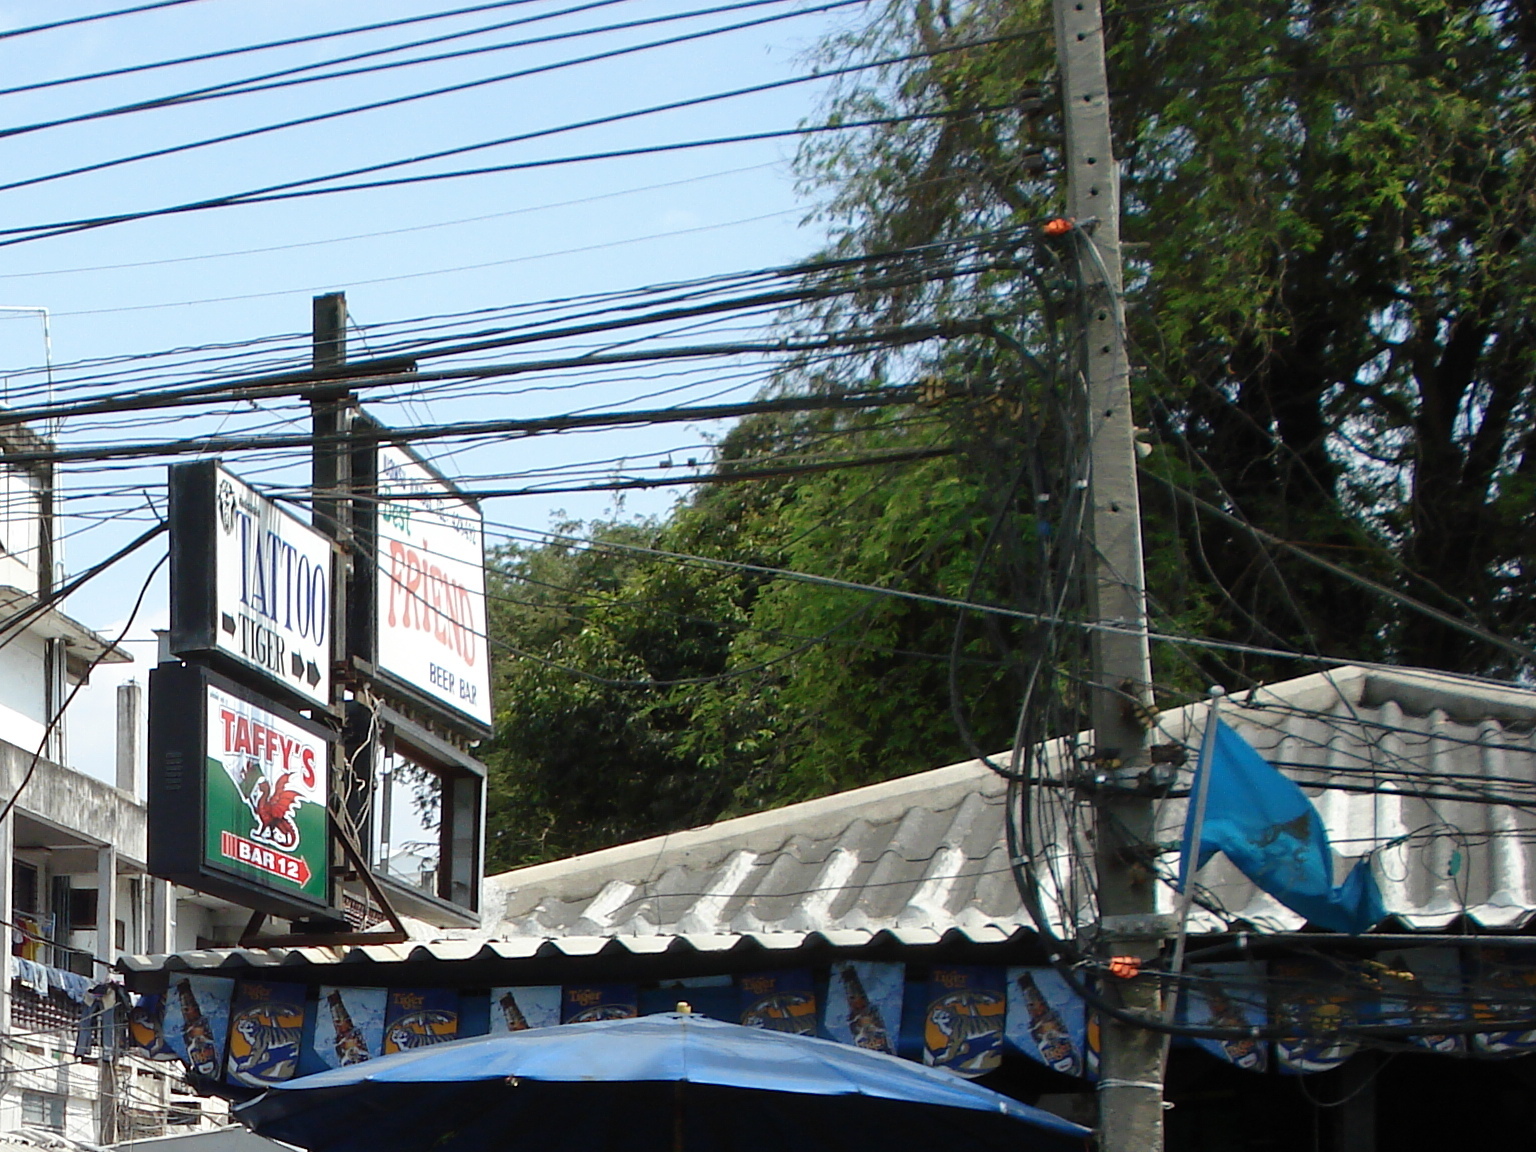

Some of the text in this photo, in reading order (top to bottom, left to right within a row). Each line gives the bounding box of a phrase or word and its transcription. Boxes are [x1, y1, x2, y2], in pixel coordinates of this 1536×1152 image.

[235, 510, 326, 647] TATTOO
[238, 613, 286, 678] TIGER
[429, 661, 477, 707] BEER BAR
[221, 708, 316, 788] TAFFY'S
[238, 840, 299, 878] BAR 12
